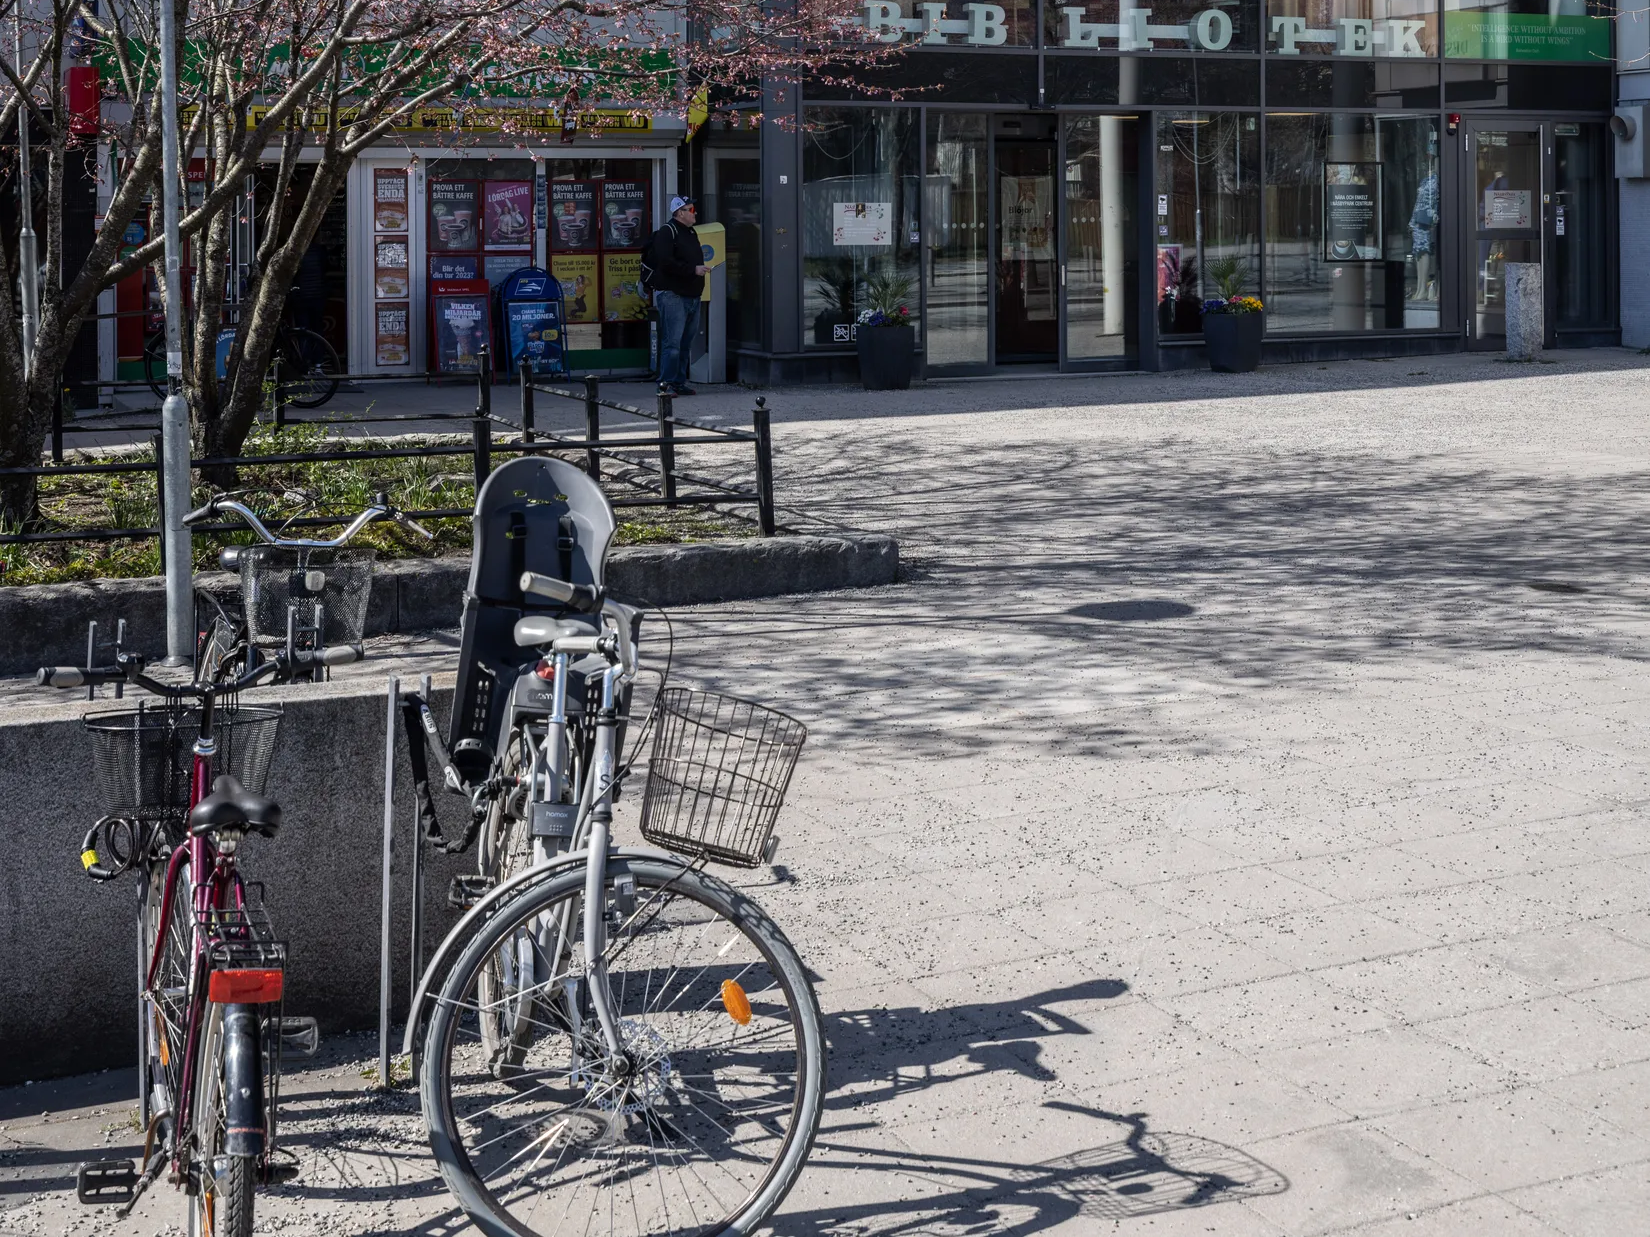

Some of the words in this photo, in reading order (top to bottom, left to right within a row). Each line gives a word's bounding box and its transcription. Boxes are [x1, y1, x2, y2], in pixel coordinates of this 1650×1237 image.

[1521, 26, 1551, 34] WITHOUT
[1553, 26, 1586, 35] AMBITION
[1481, 35, 1489, 43] IS
[1514, 36, 1546, 44] WITHOUT
[553, 184, 572, 192] PROVA
[605, 183, 624, 191] PROVA
[625, 183, 635, 191] ETT
[378, 189, 405, 198] ENDA
[433, 191, 455, 200] BÄTTRE
[456, 192, 474, 200] KAFFE
[488, 190, 514, 203] LÖRDAG
[514, 186, 529, 196] LIVE
[553, 191, 574, 199] BÄTTRE
[605, 190, 626, 198] BÄTTRE
[379, 321, 406, 331] ENDA
[218, 332, 236, 342] LÖRDA
